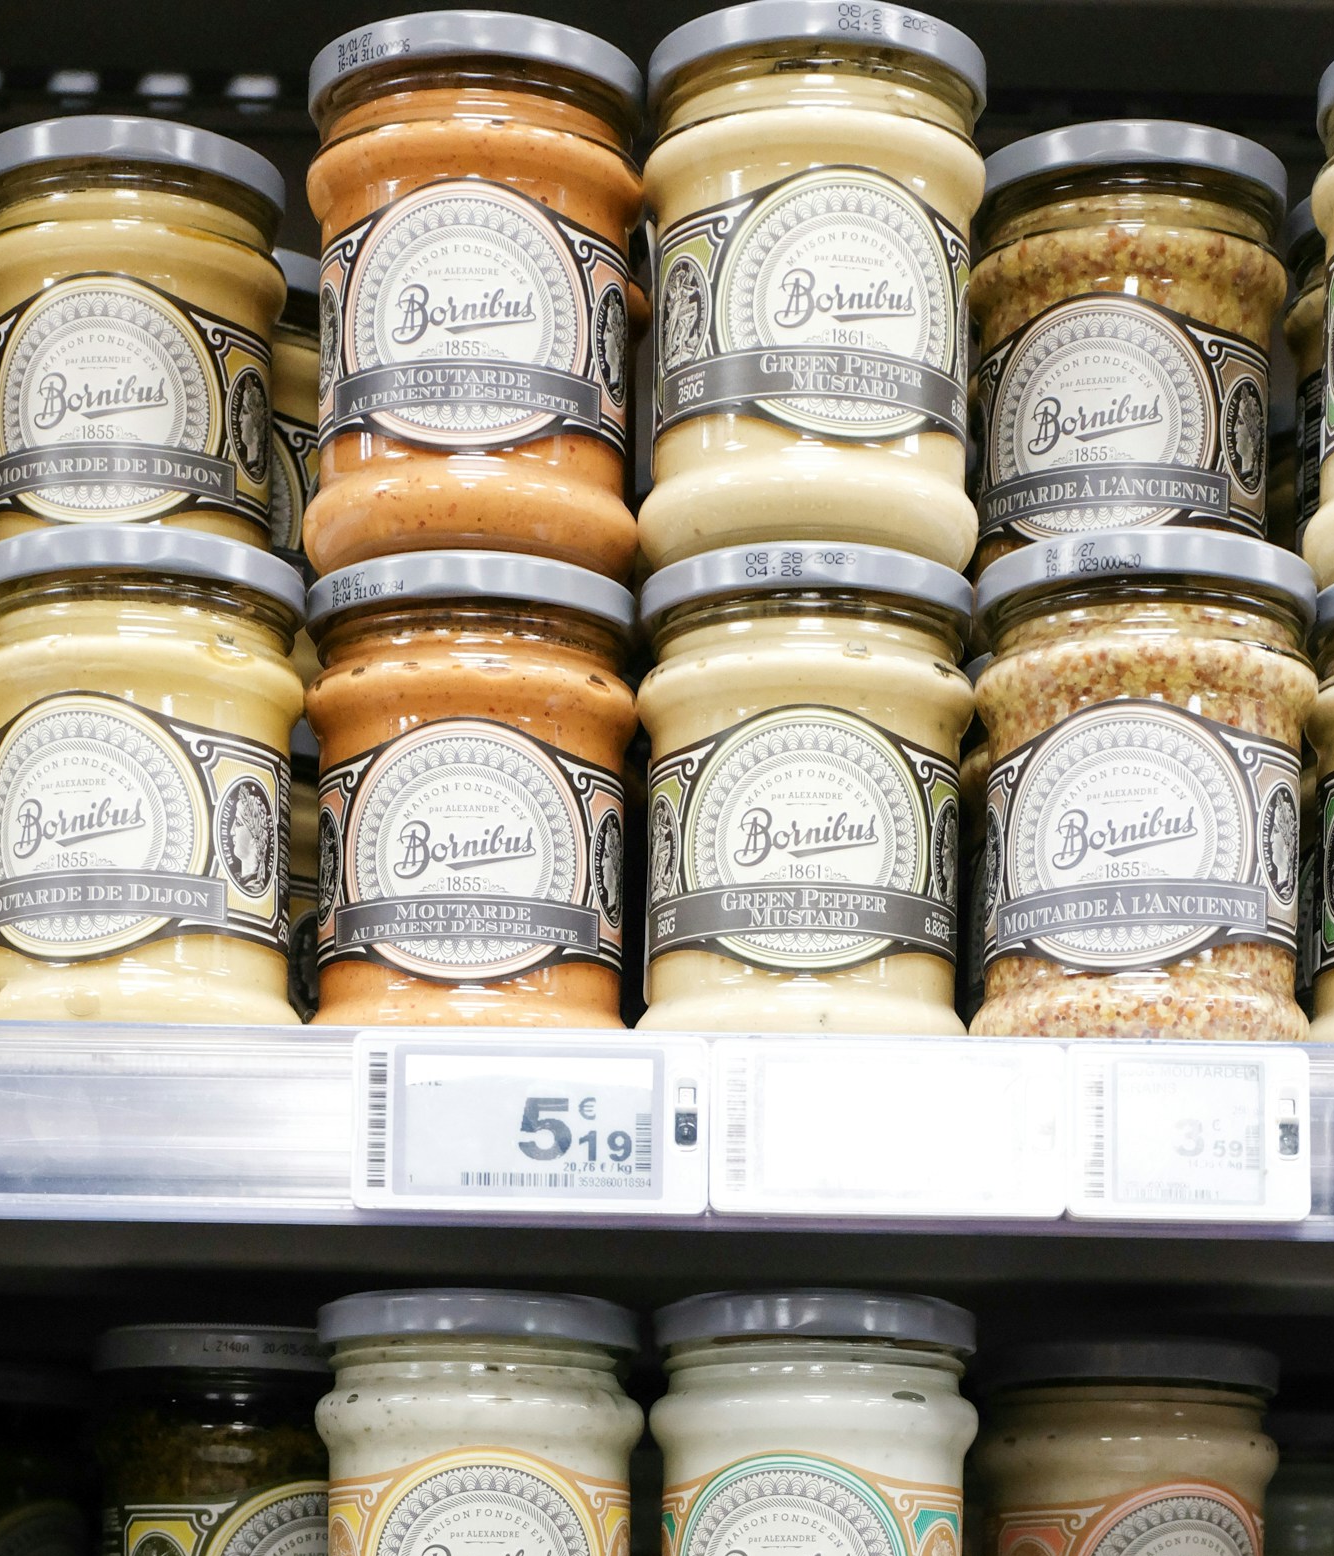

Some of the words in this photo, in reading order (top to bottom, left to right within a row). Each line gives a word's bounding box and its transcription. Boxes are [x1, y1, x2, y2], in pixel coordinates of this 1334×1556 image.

[392, 284, 536, 345] Bornibus
[392, 368, 531, 389] MOUTARDE
[348, 400, 367, 412] AU
[370, 389, 443, 410] PIMENT
[734, 807, 878, 867] Bornibus
[788, 864, 821, 879] 1861
[721, 891, 793, 911] GREEN
[800, 889, 887, 915] PEPPER
[748, 908, 858, 928] MUSTARD
[1003, 898, 1108, 938] MOUTARDE
[1114, 894, 1125, 919] À
[1131, 895, 1258, 921] L'ANCIENNE
